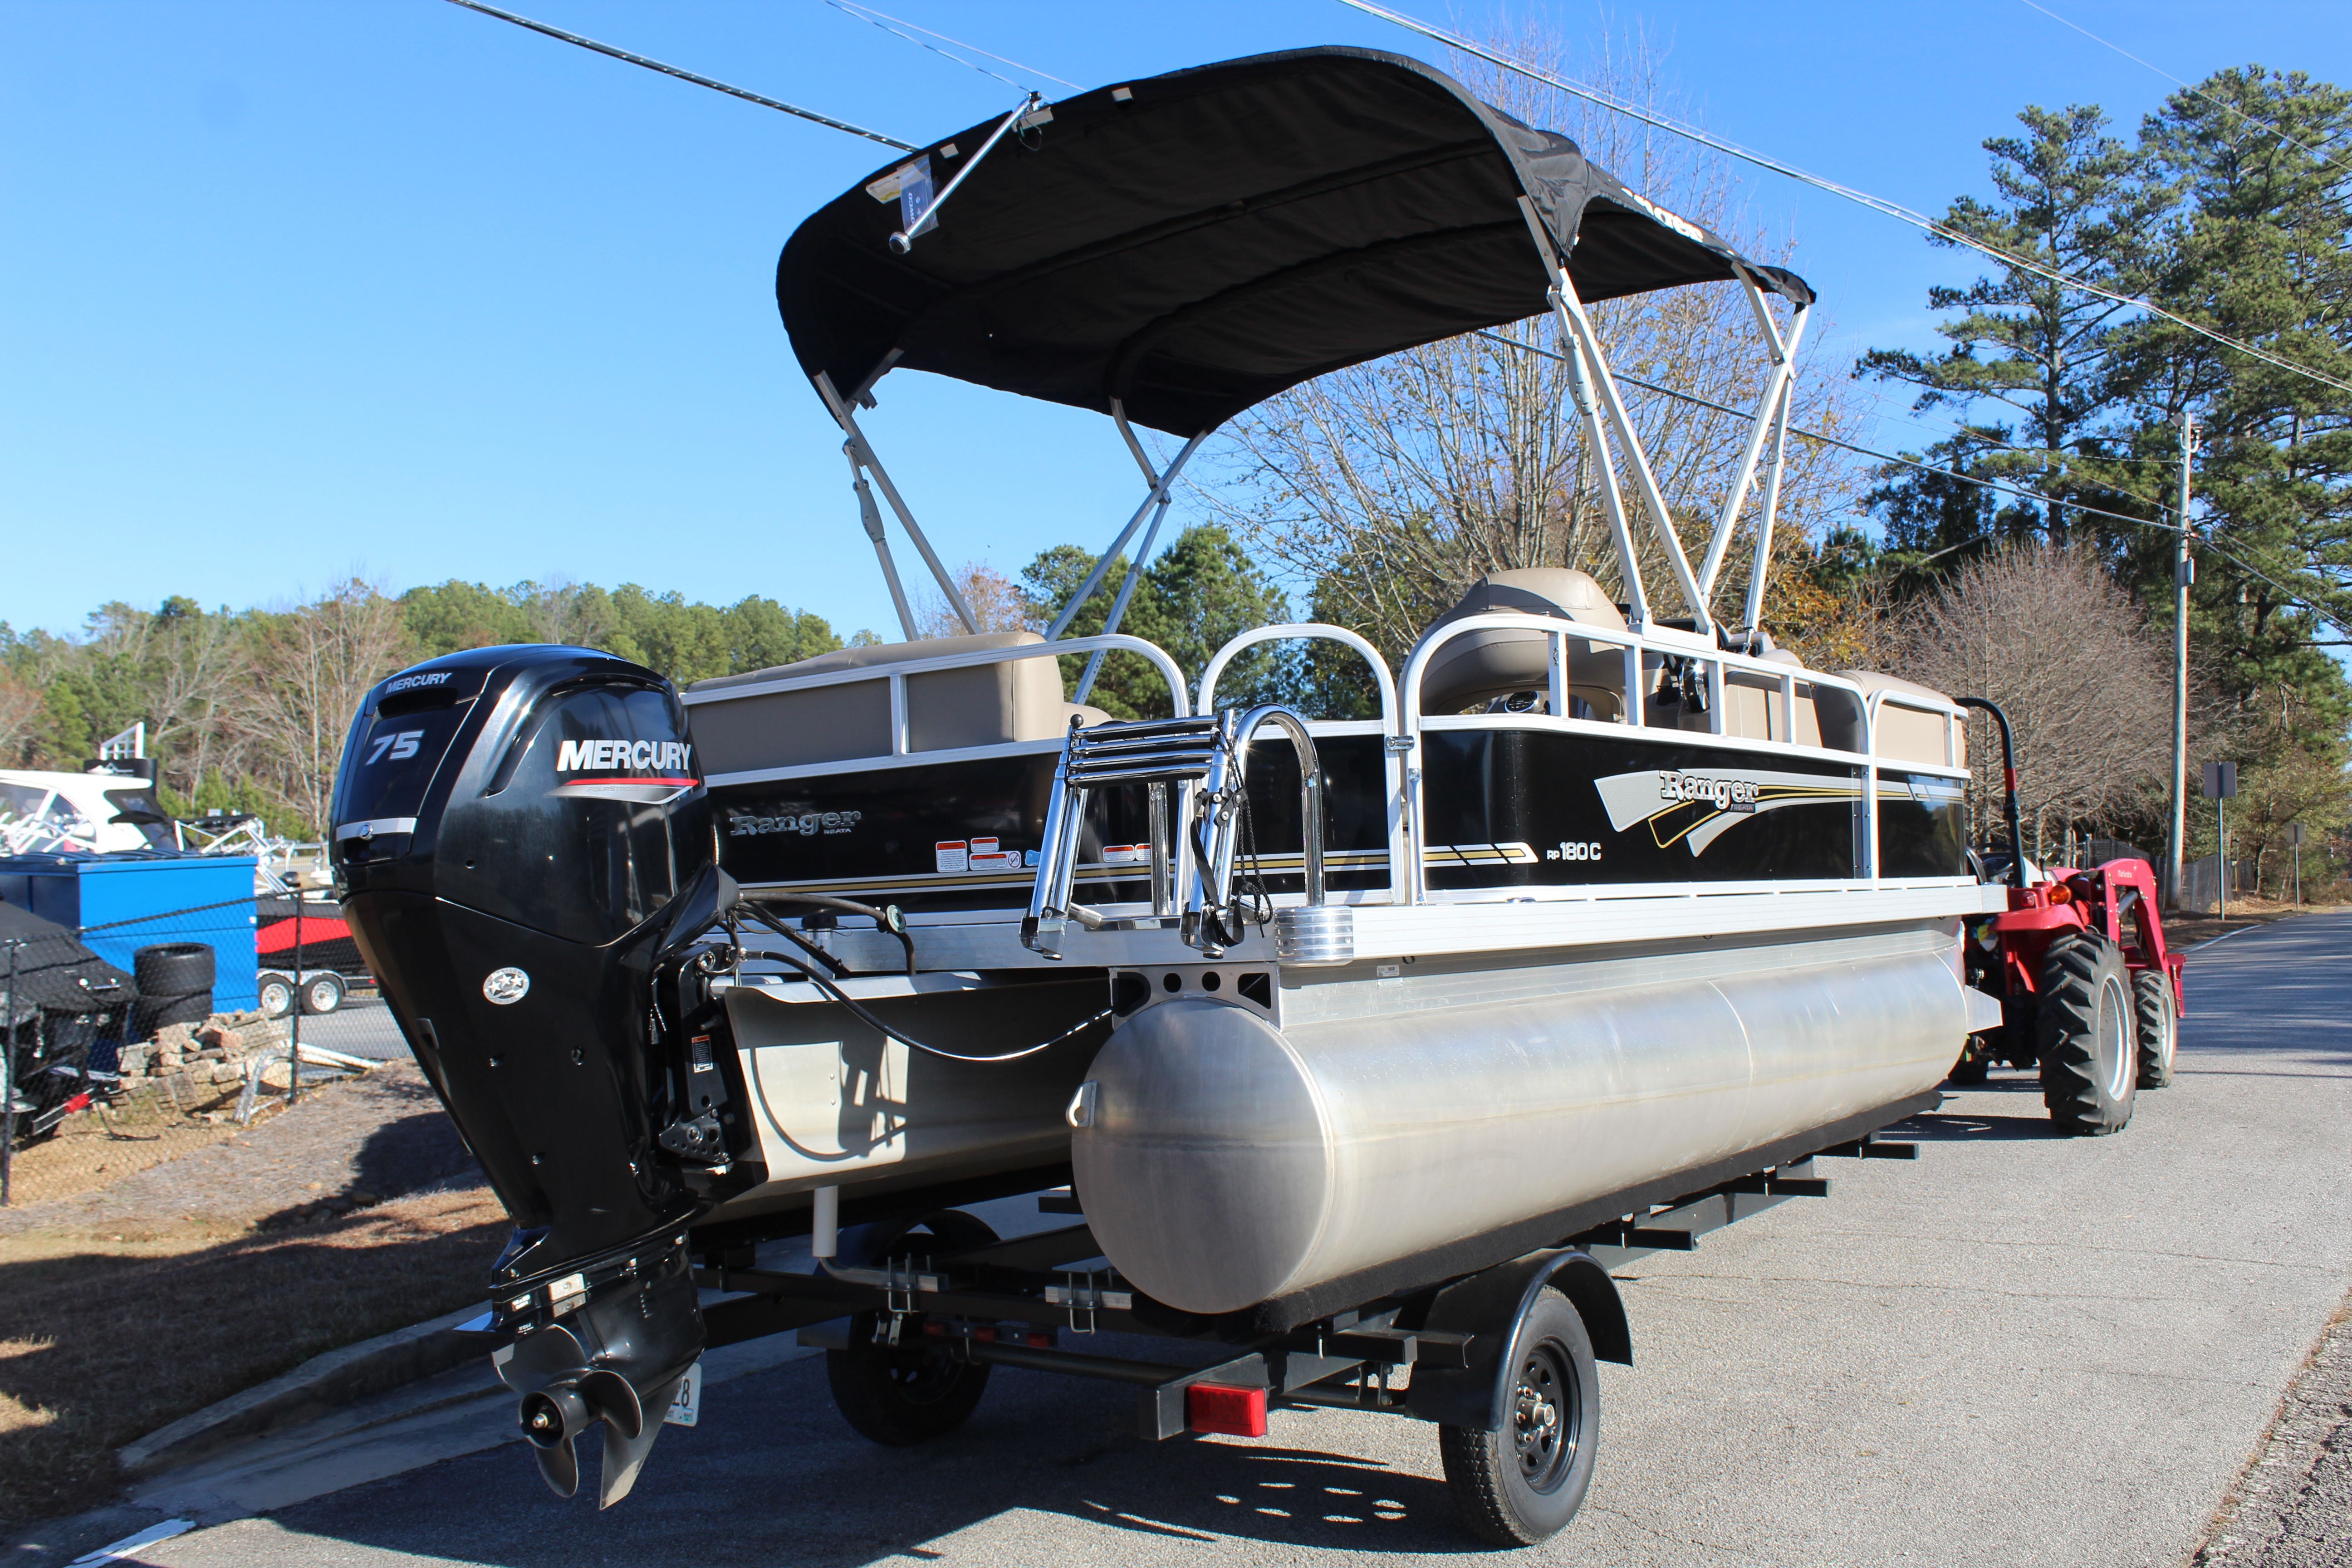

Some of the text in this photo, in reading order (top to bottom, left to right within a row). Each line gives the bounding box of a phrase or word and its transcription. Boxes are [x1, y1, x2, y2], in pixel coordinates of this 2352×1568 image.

[386, 672, 453, 694] MERCURY
[364, 729, 425, 766] 75
[556, 740, 691, 772] MERCURY
[1659, 769, 1759, 810] Ranger
[730, 811, 862, 836] Ranger
